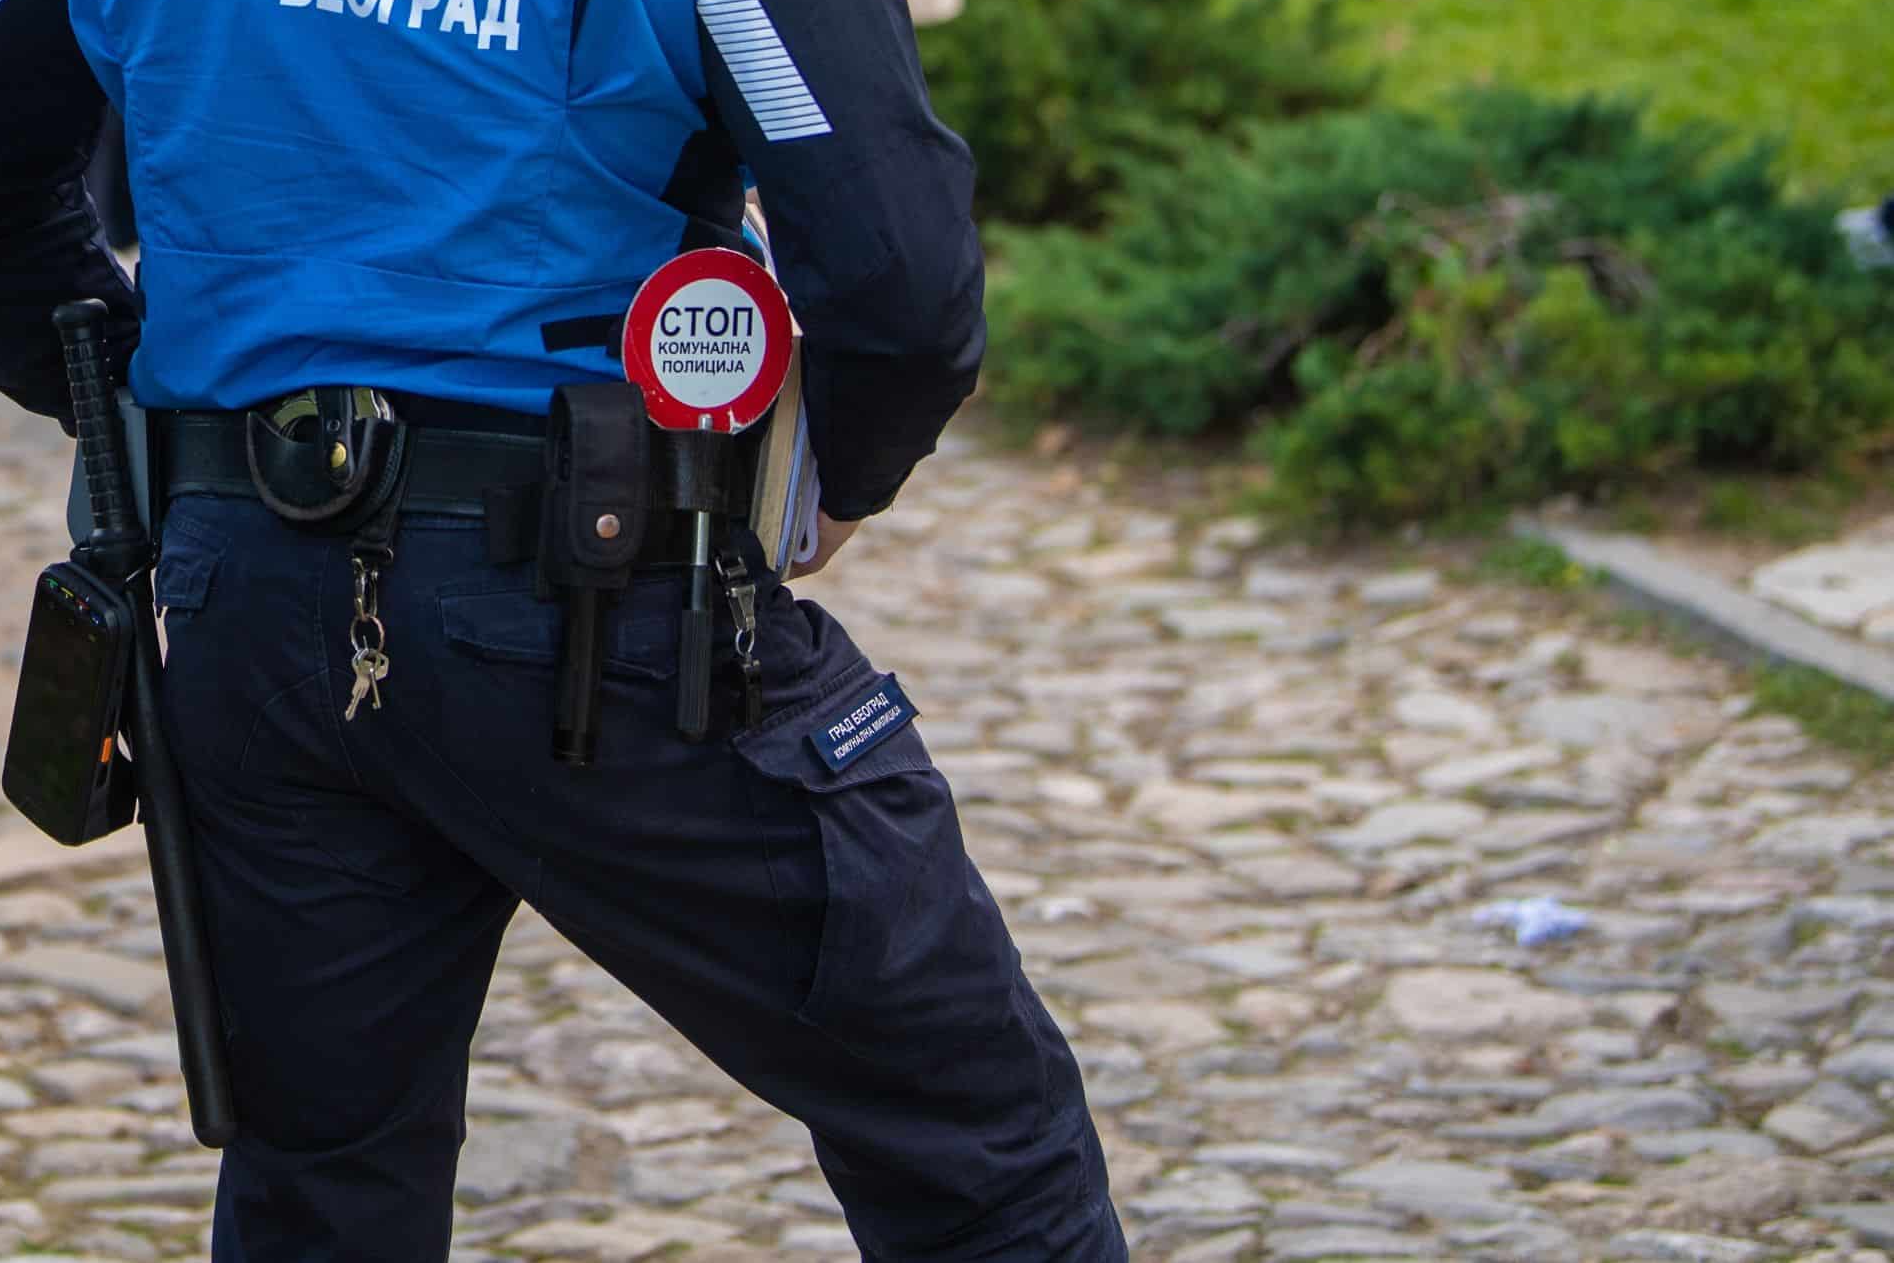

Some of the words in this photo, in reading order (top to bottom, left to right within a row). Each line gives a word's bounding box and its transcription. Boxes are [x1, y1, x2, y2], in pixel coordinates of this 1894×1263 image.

[660, 306, 754, 337] СТОП
[658, 341, 751, 355] КОМУНАЛНА
[662, 360, 745, 375] ПОЛИЦИЈА
[828, 717, 858, 742] ГРАД
[850, 691, 890, 726] БЕОГРАД
